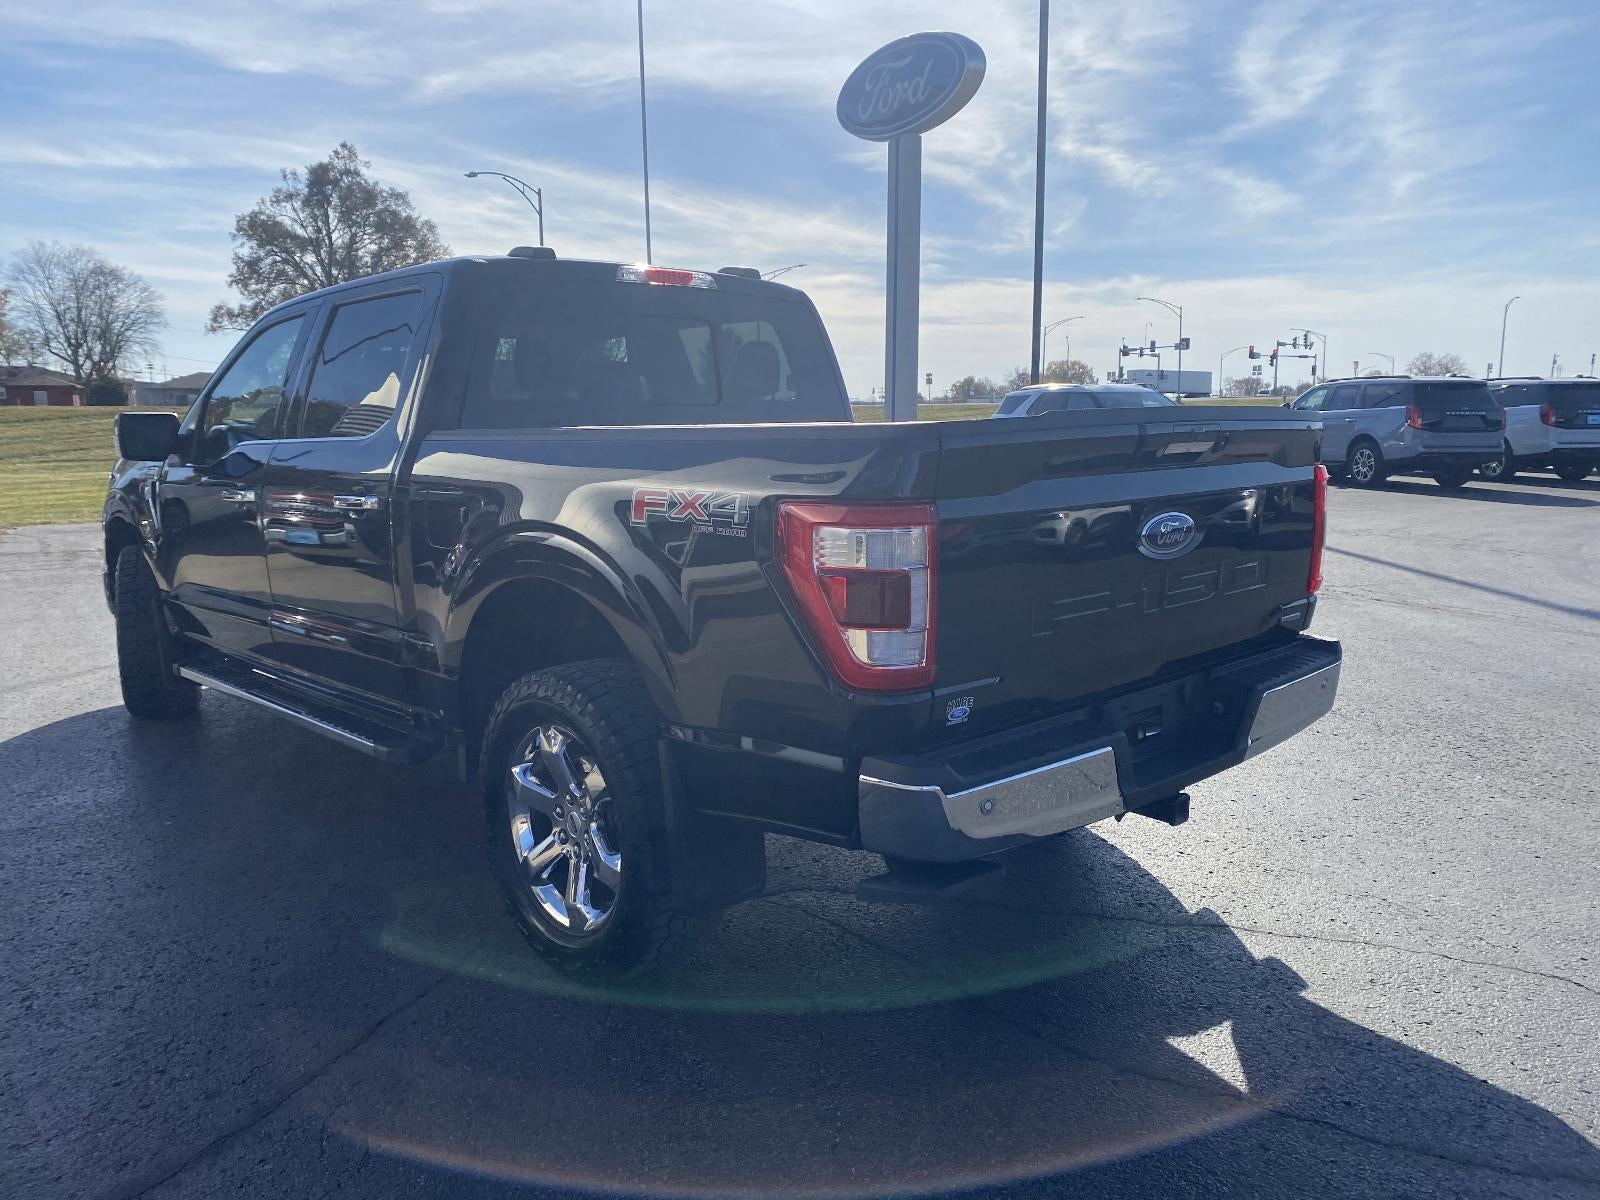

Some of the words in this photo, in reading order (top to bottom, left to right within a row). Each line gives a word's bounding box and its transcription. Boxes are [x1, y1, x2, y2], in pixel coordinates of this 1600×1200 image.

[858, 55, 934, 120] Ford
[630, 487, 750, 528] FX4
[1157, 521, 1187, 545] Ford
[1031, 553, 1269, 638] F-150
